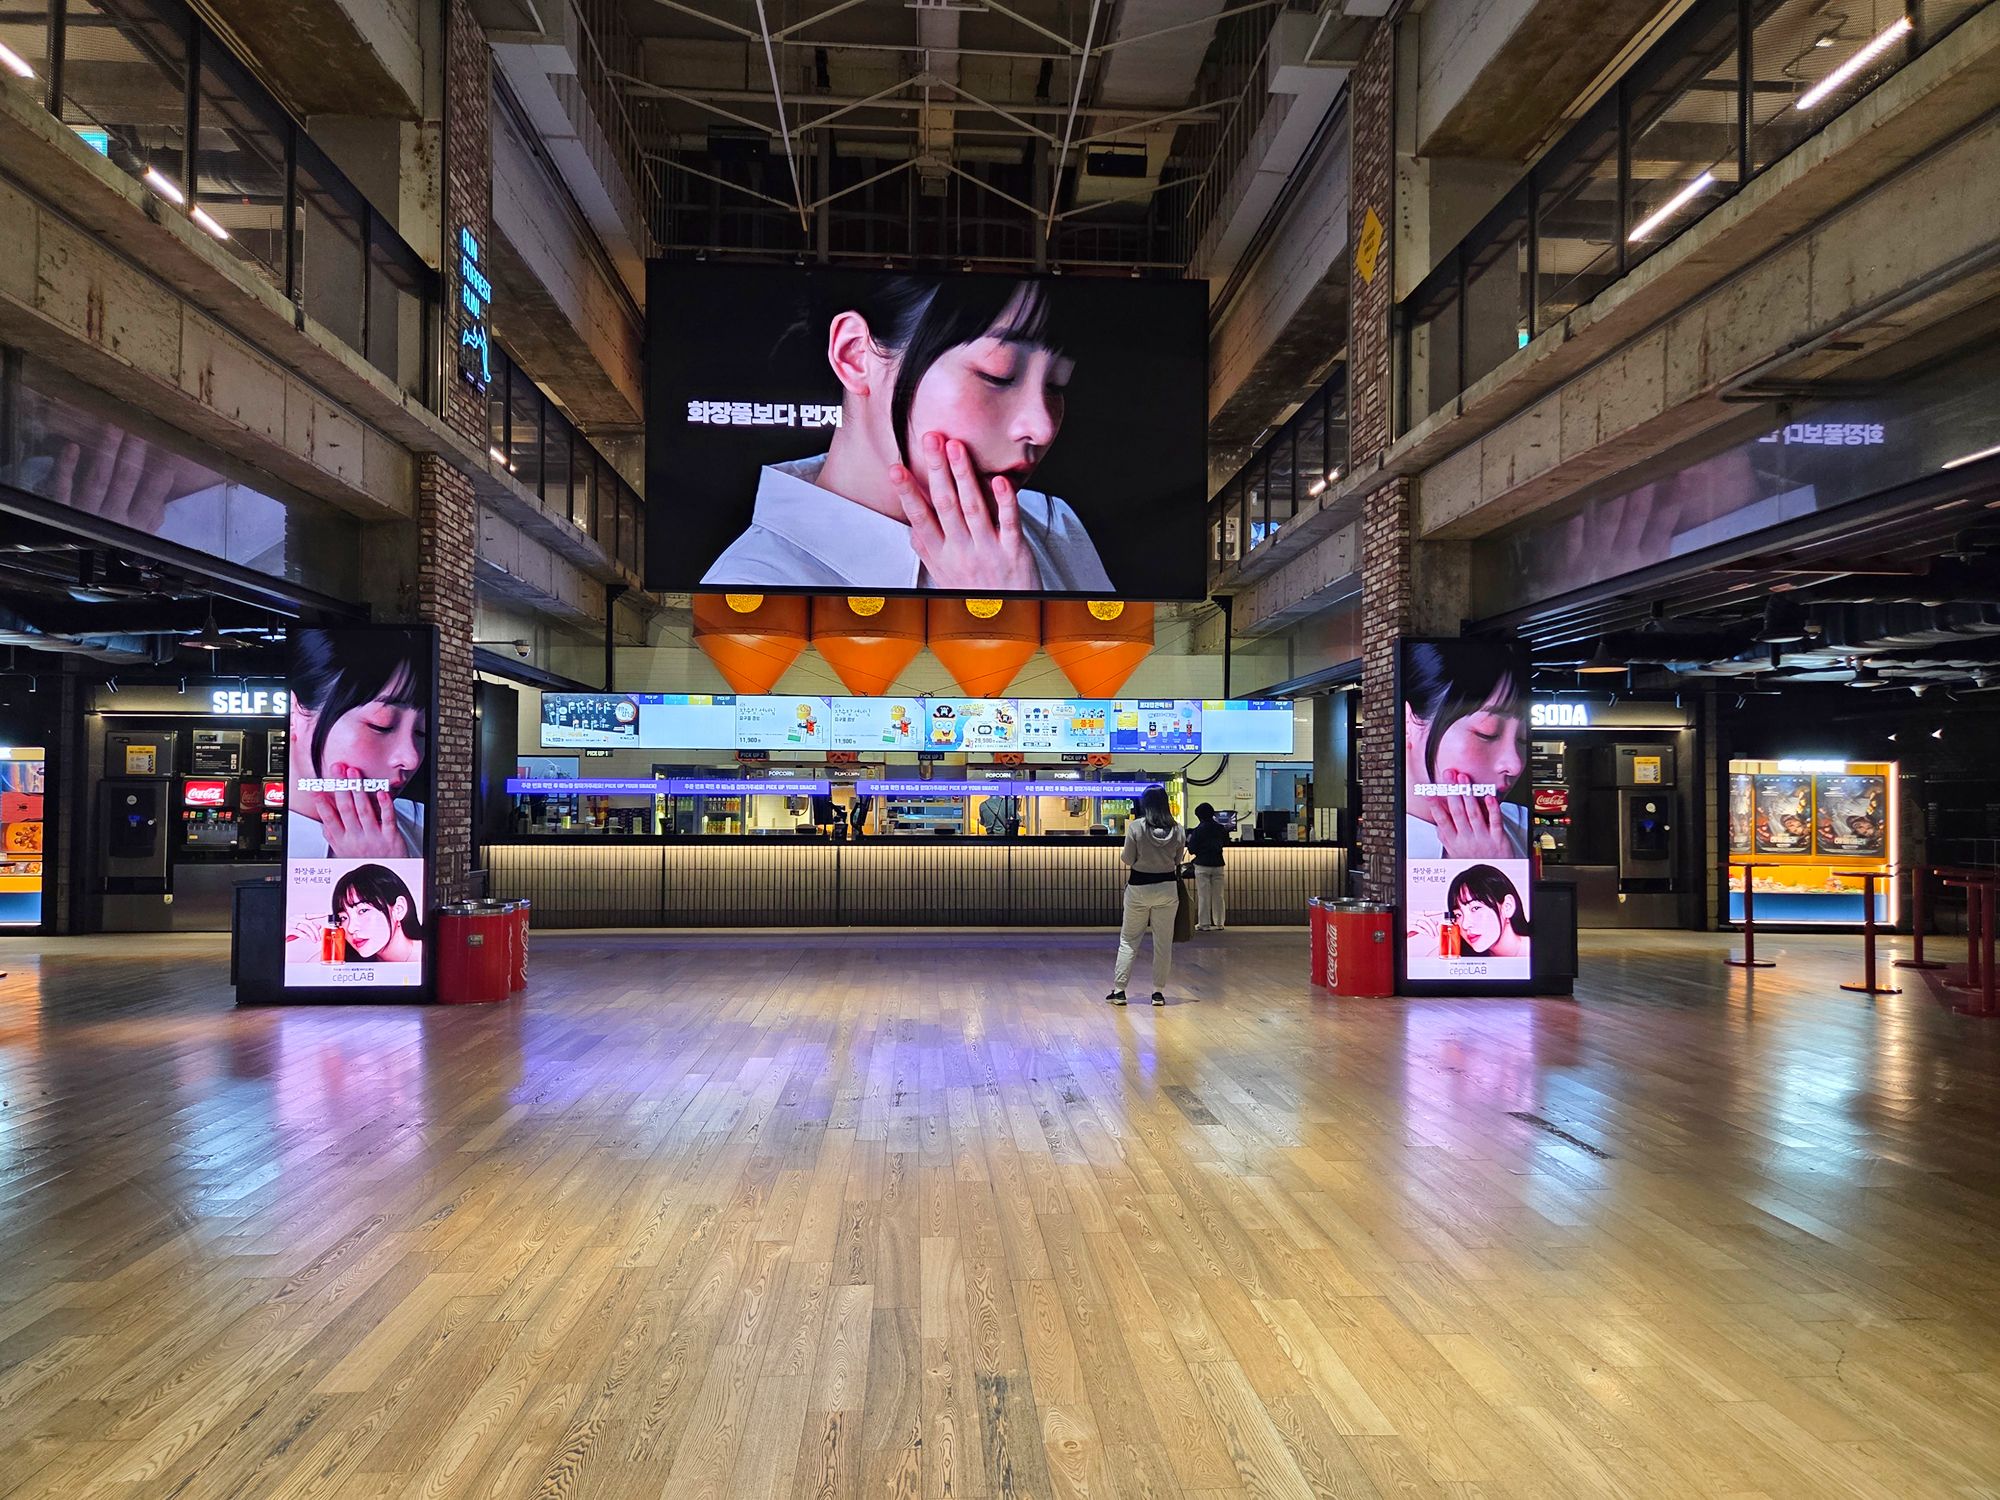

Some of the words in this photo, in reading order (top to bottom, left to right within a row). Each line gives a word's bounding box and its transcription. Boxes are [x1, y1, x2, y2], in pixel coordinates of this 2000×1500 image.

[462, 227, 478, 262] RUN
[463, 256, 492, 304] FORREST
[463, 284, 480, 320] RUN!
[687, 401, 797, 427] 화장품보다
[799, 404, 843, 428] 먼저
[212, 691, 268, 714] SELF
[1531, 704, 1588, 726] SODA
[298, 778, 362, 792] 화장품보다
[363, 778, 390, 792] 먼저
[1414, 784, 1471, 796] 화장품보다
[1472, 784, 1496, 796] 먼저
